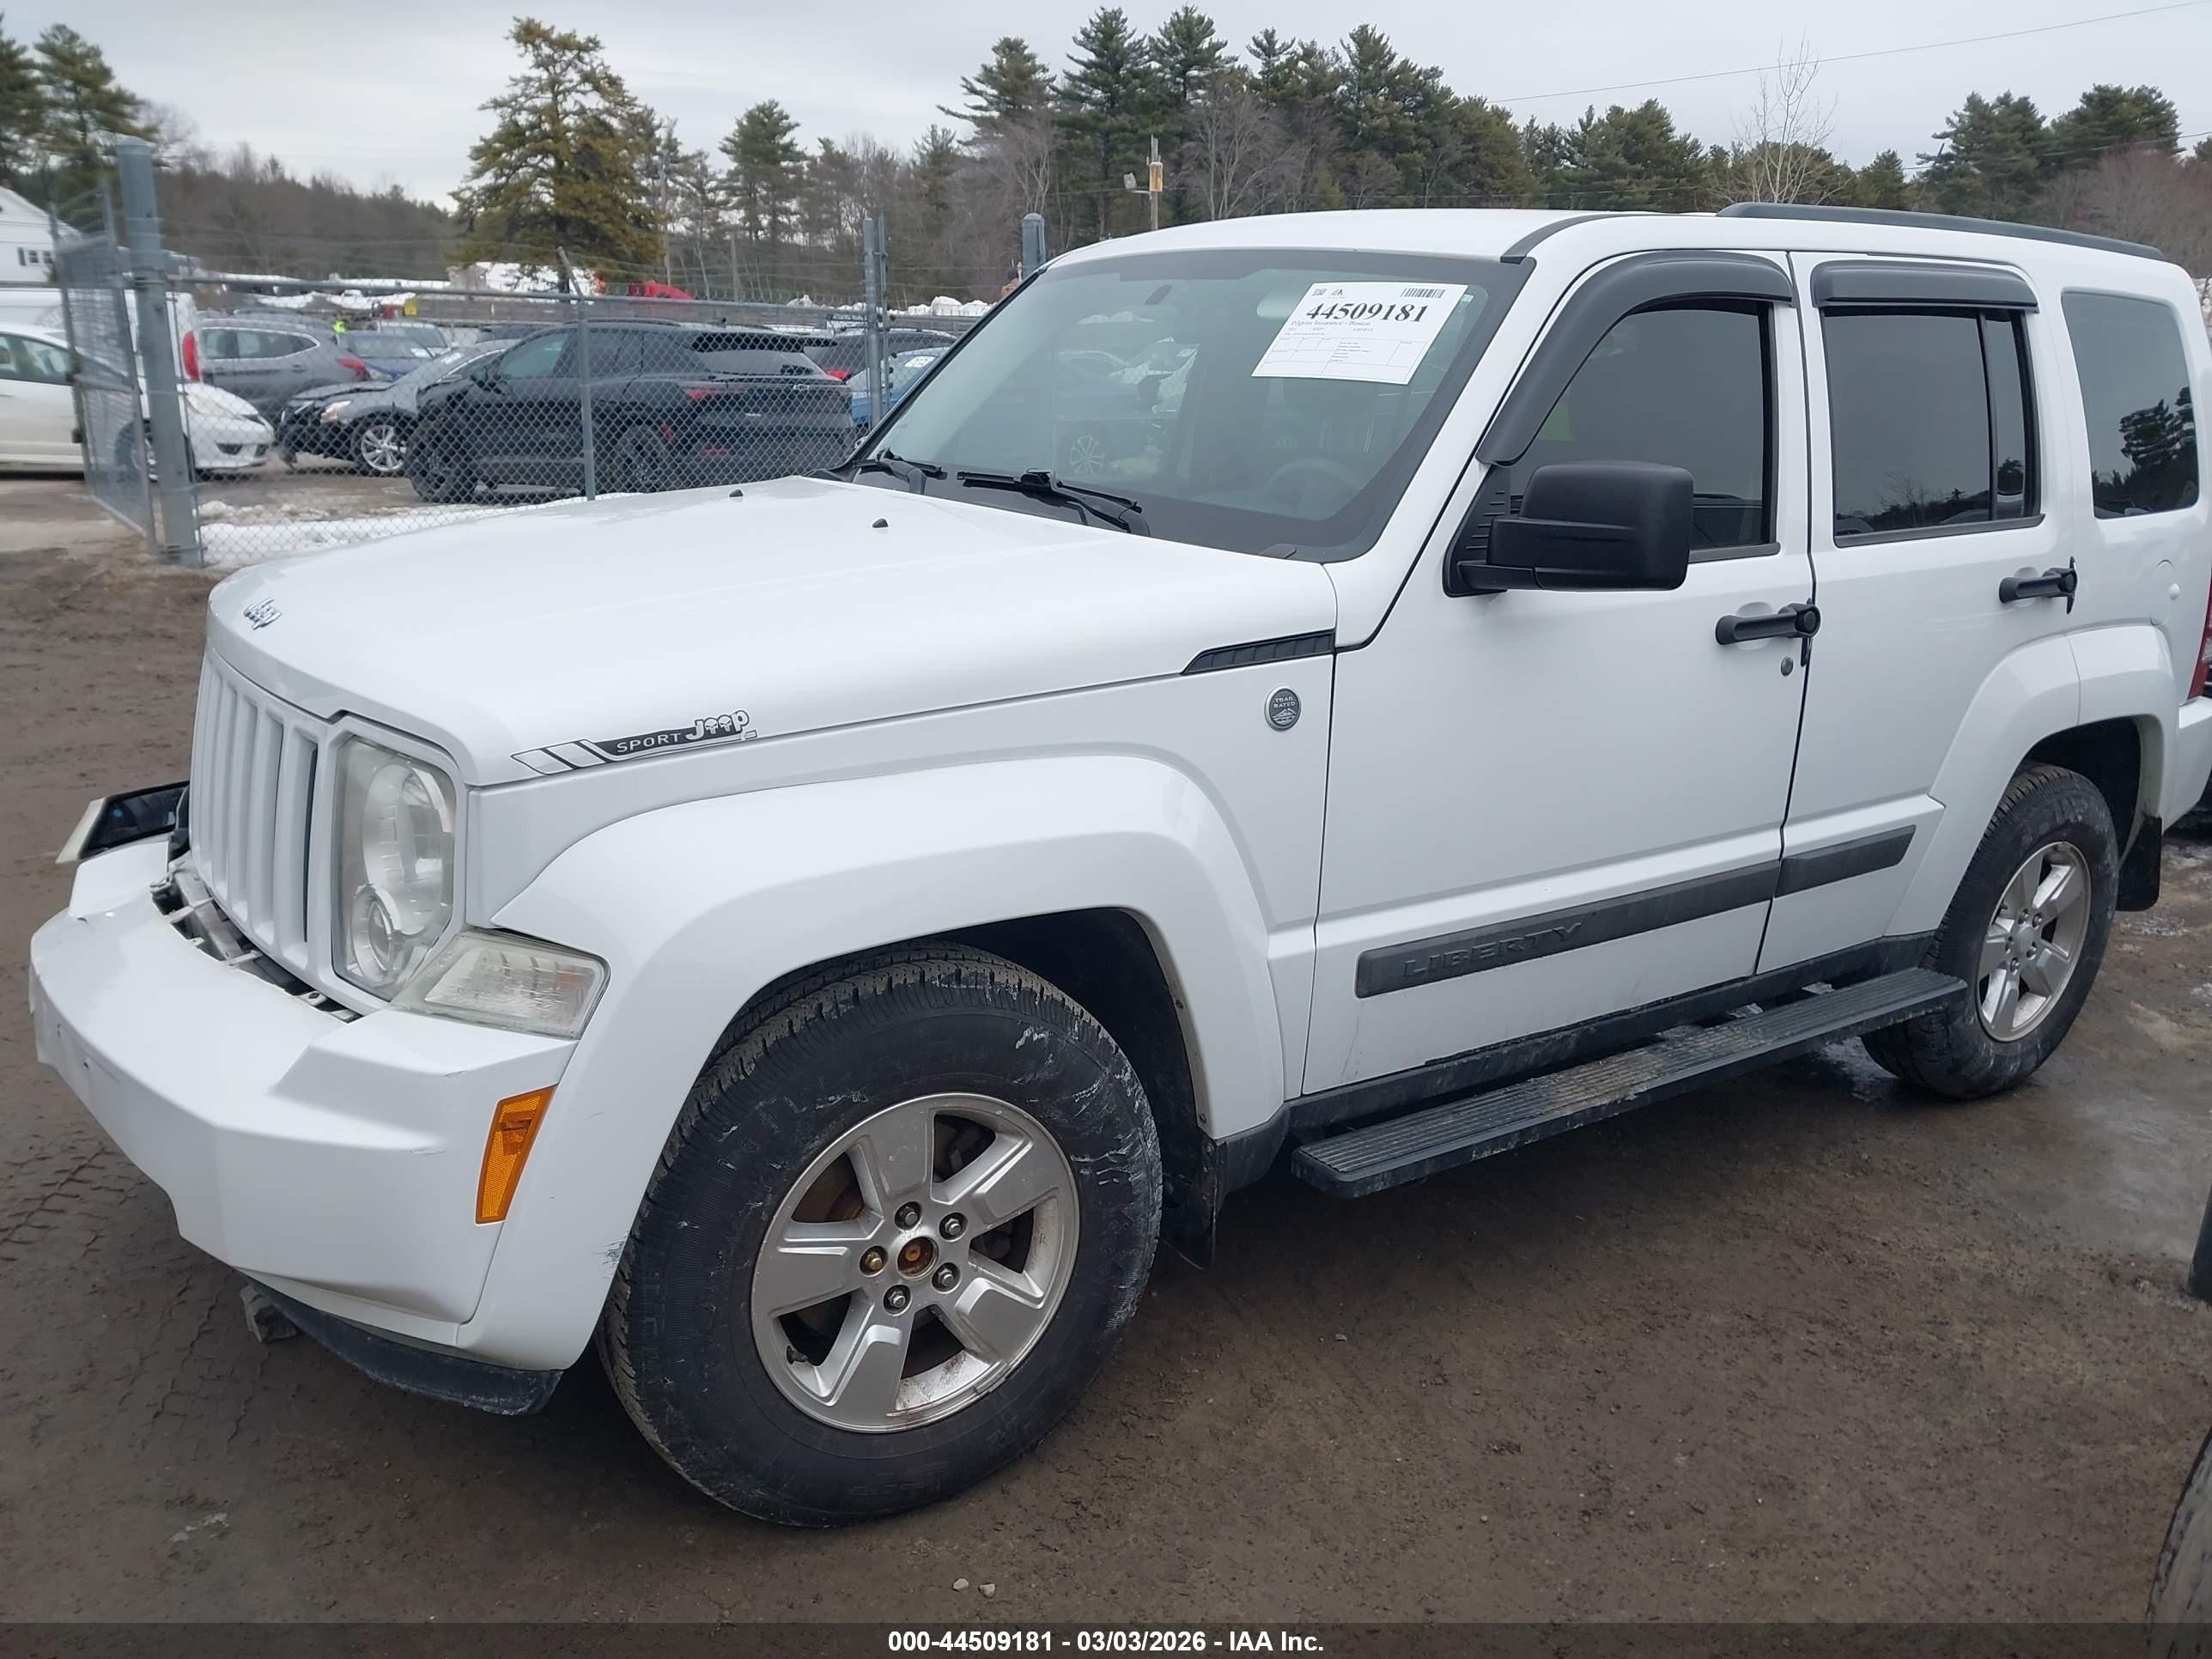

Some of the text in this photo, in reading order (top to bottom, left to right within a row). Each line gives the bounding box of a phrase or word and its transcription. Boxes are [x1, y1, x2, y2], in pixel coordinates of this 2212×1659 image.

[1306, 302, 1429, 322] 44509181
[616, 732, 683, 754] SPORT
[1403, 921, 1582, 977] LIBERTY
